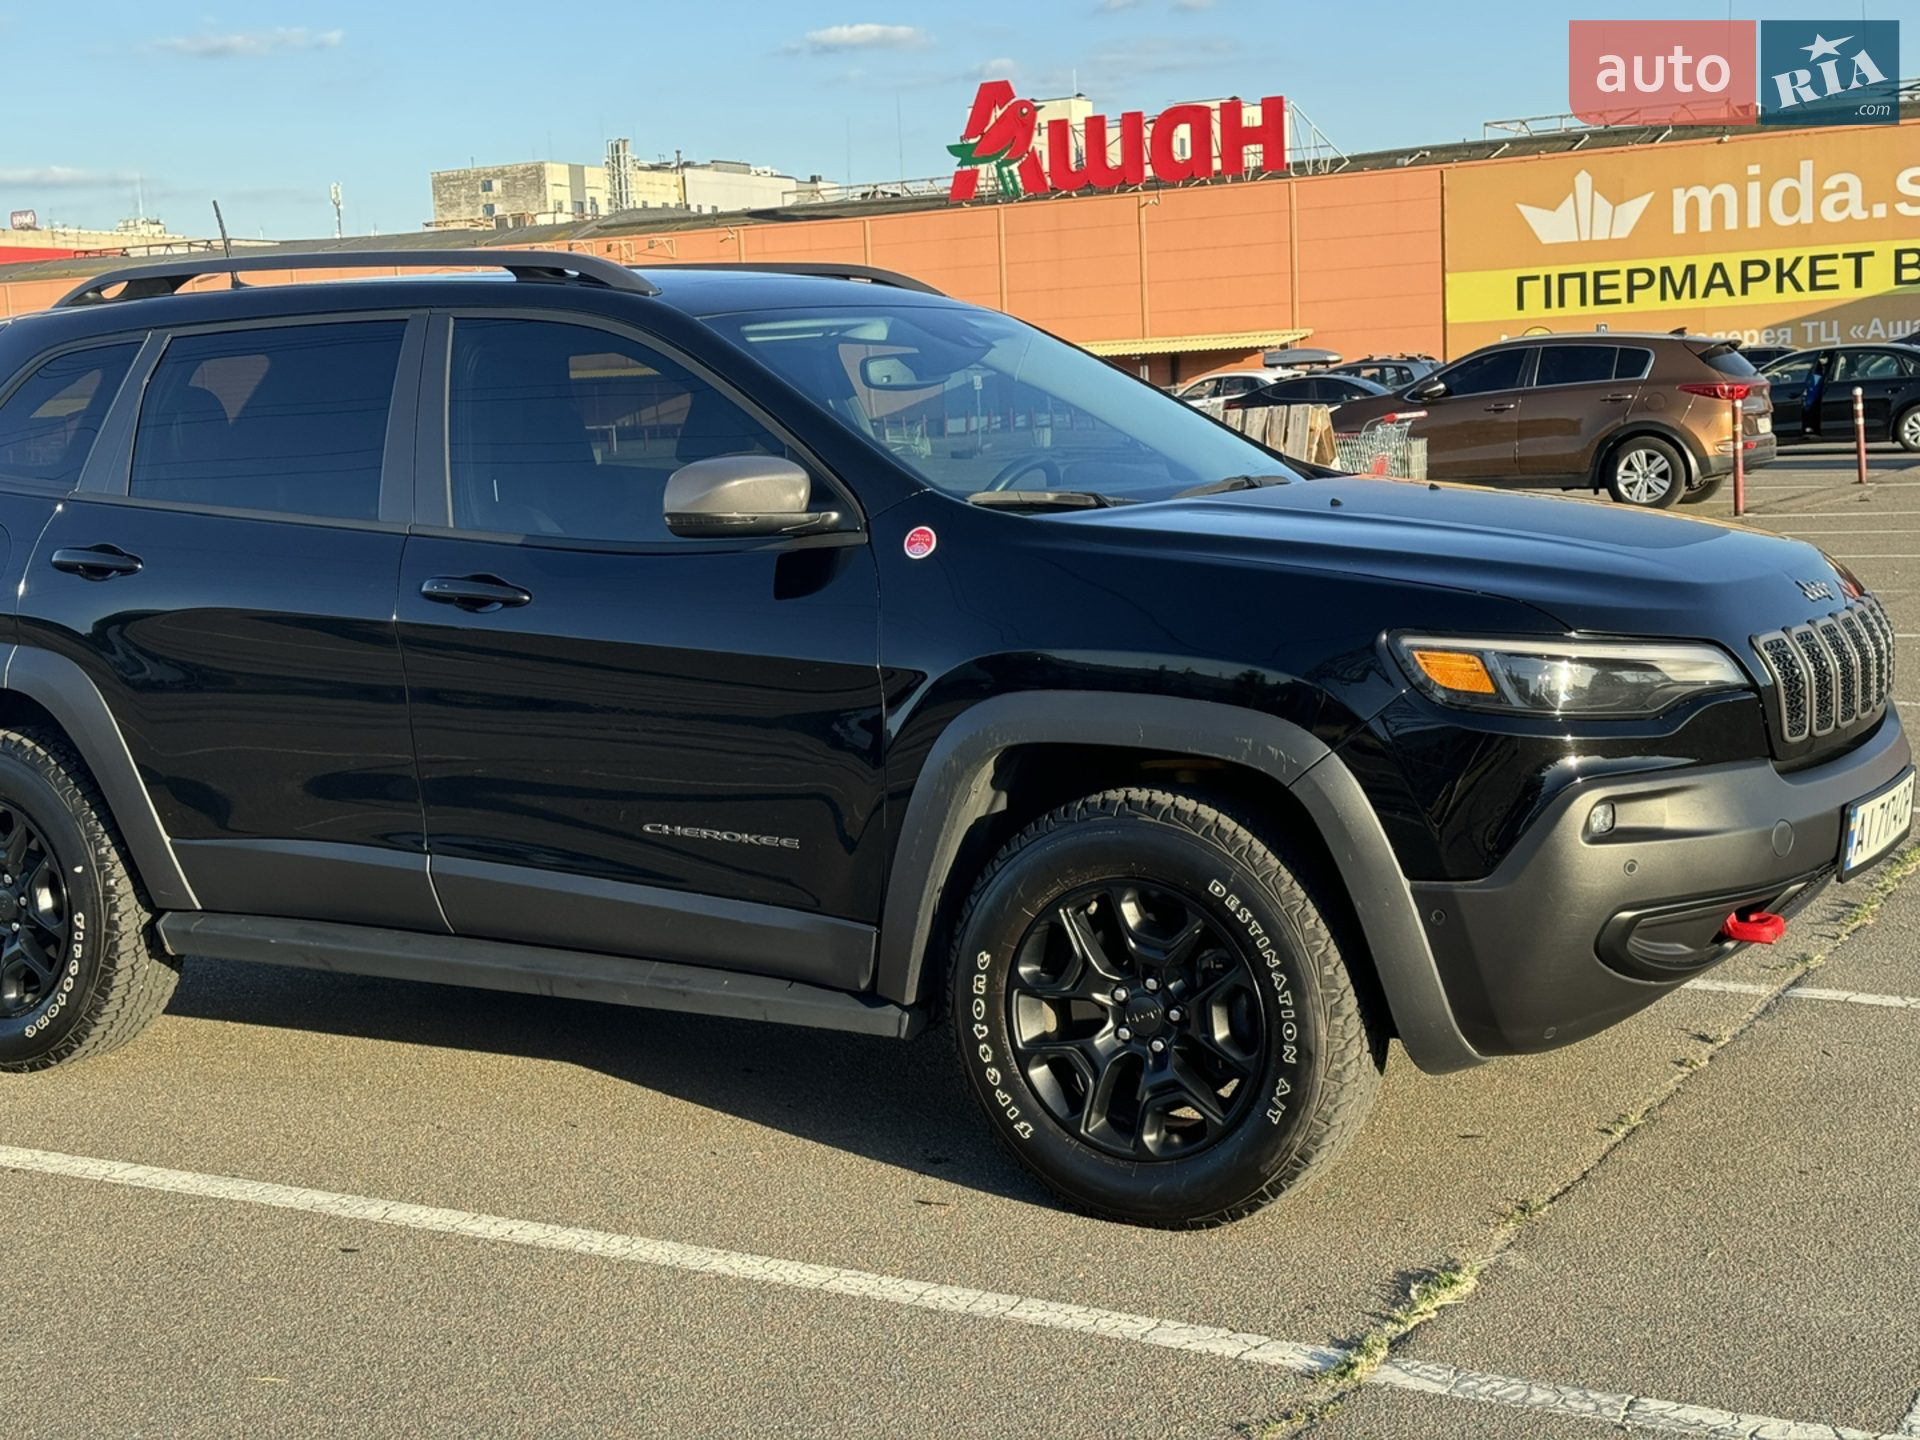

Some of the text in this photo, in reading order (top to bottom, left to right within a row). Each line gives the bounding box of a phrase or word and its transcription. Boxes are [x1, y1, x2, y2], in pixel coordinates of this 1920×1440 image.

[1516, 251, 1875, 312] ГІПЕРМАРКЕТ
[1801, 320, 1840, 345] ТЦ
[1794, 579, 1835, 603] Jeep
[642, 823, 799, 849] CHEROKEE
[25, 911, 85, 1038] Firestone
[1208, 879, 1297, 1125] DESTINATION A/T
[973, 951, 1034, 1139] Firestone
